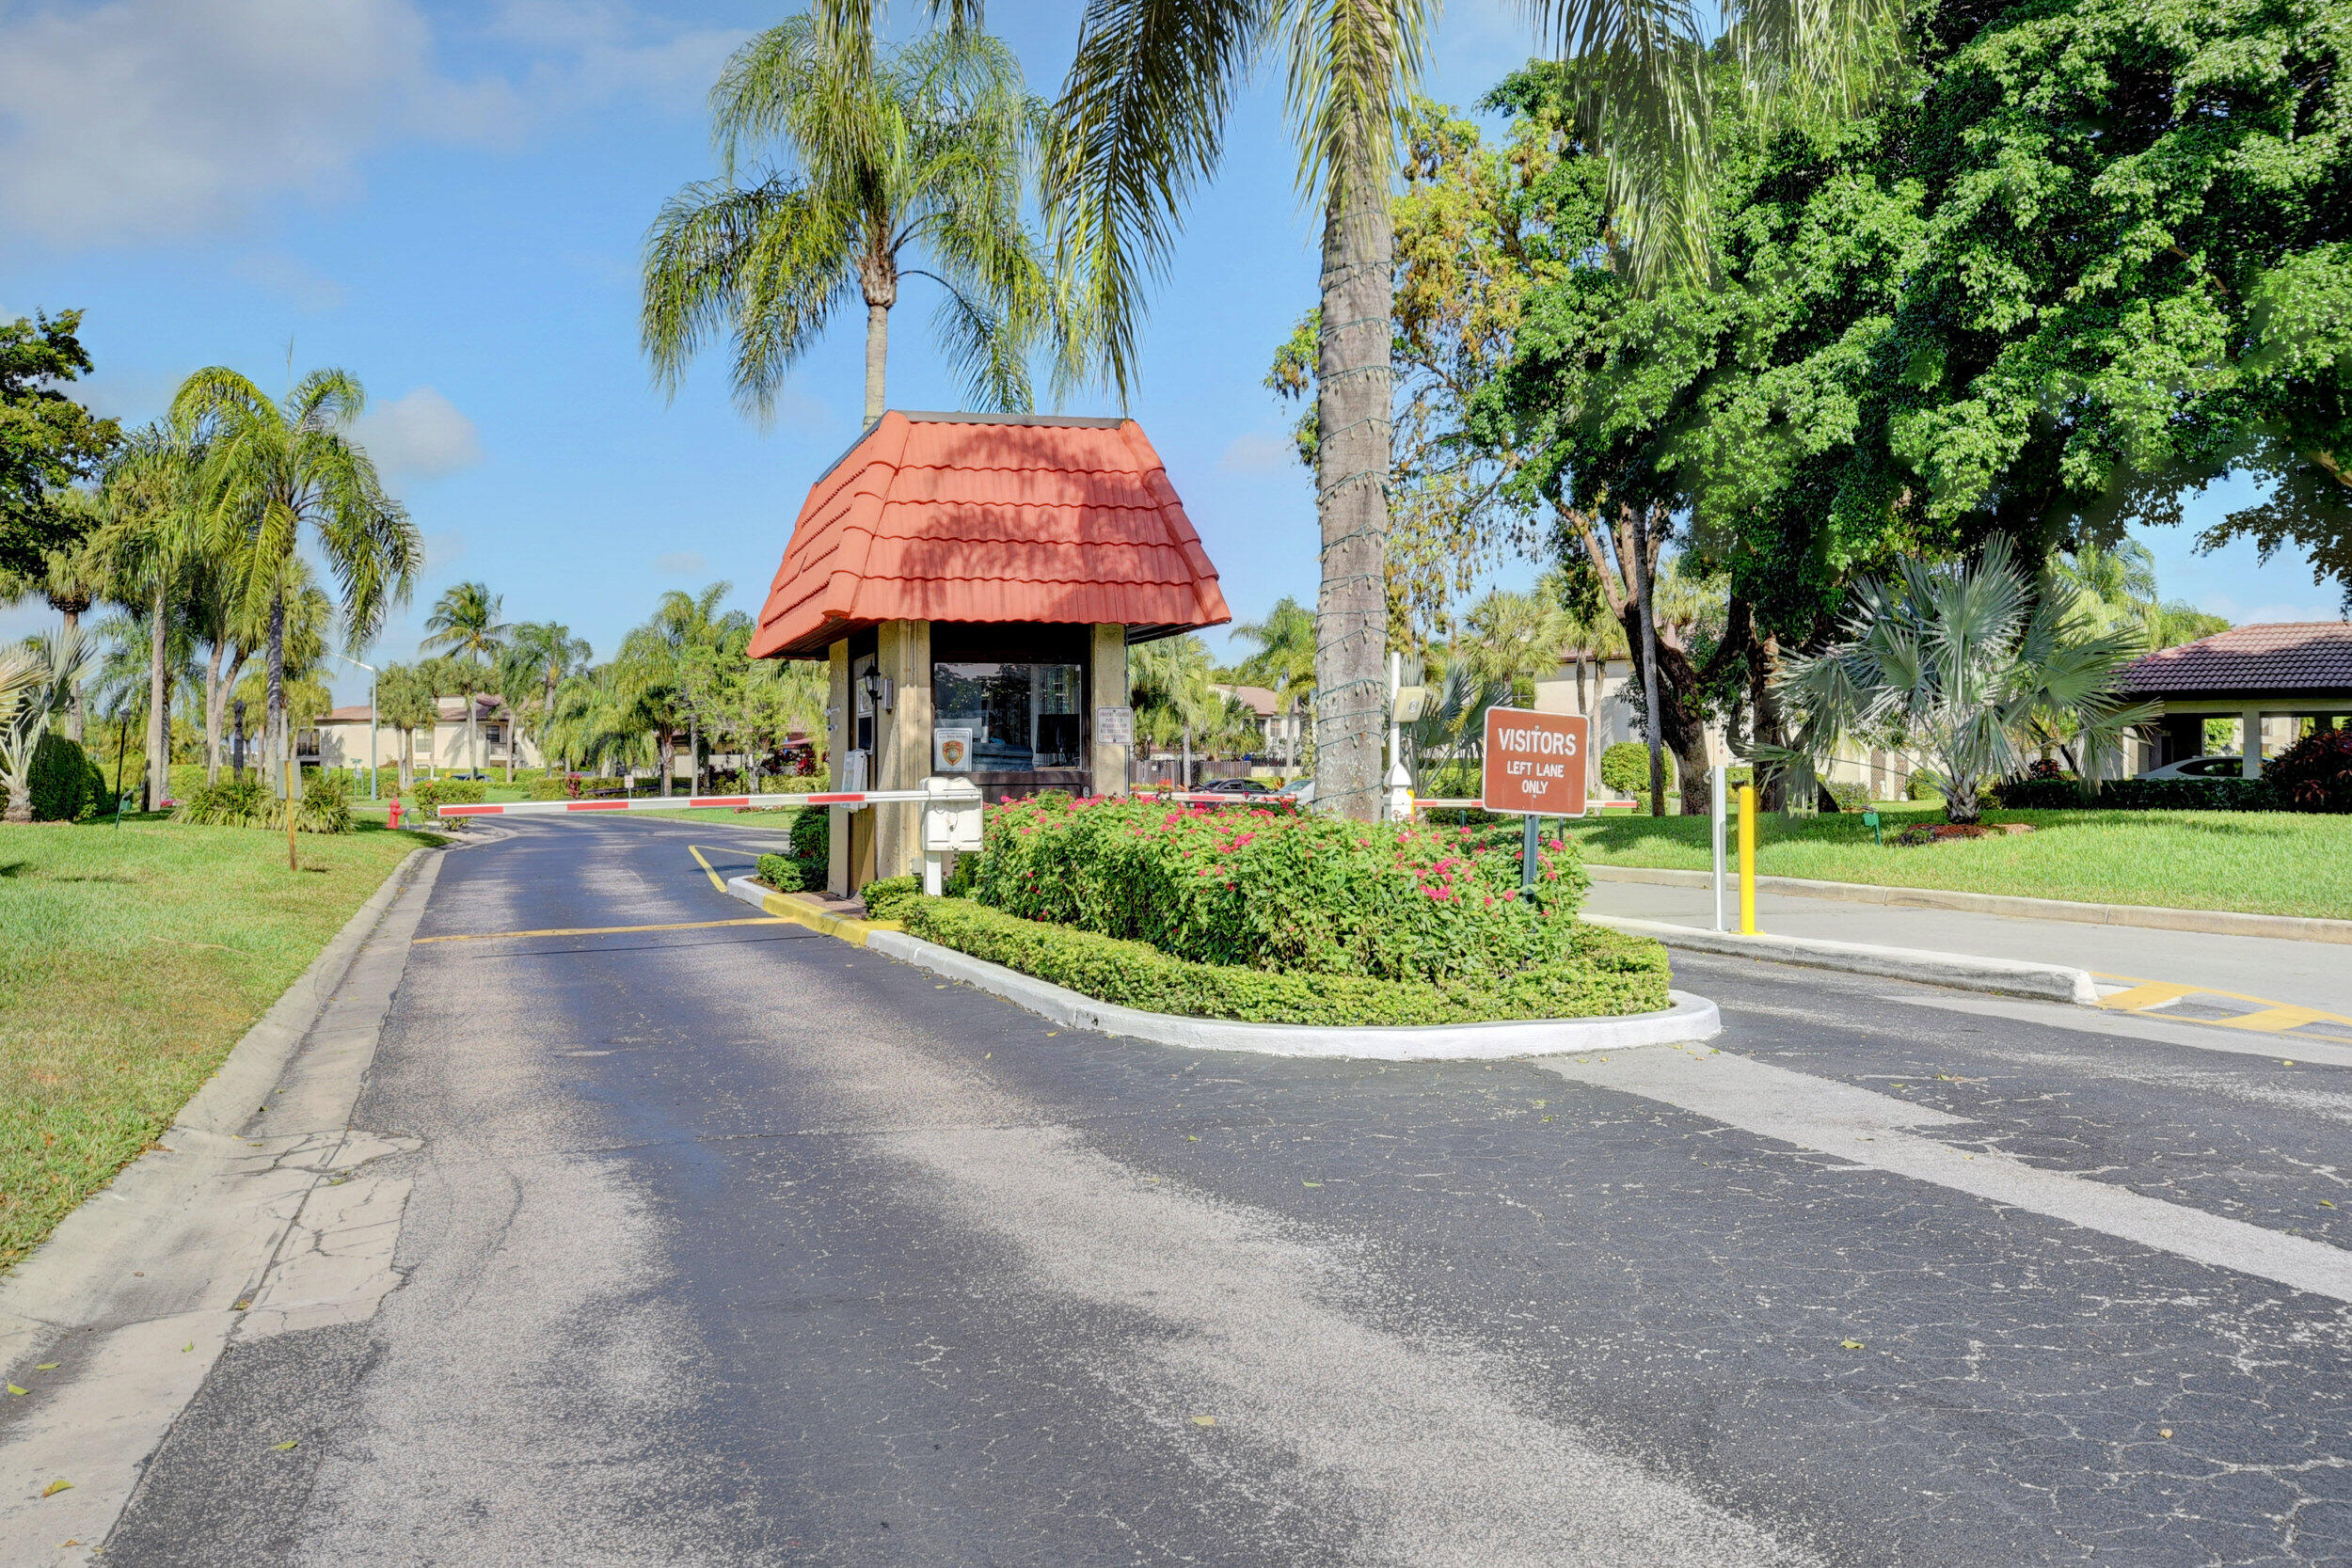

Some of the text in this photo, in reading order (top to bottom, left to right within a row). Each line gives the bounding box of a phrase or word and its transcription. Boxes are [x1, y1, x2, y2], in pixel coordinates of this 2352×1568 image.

[1498, 727, 1577, 756] VISITORS
[1507, 760, 1565, 778] LEFT LANE
[1521, 779, 1549, 795] ONLY
